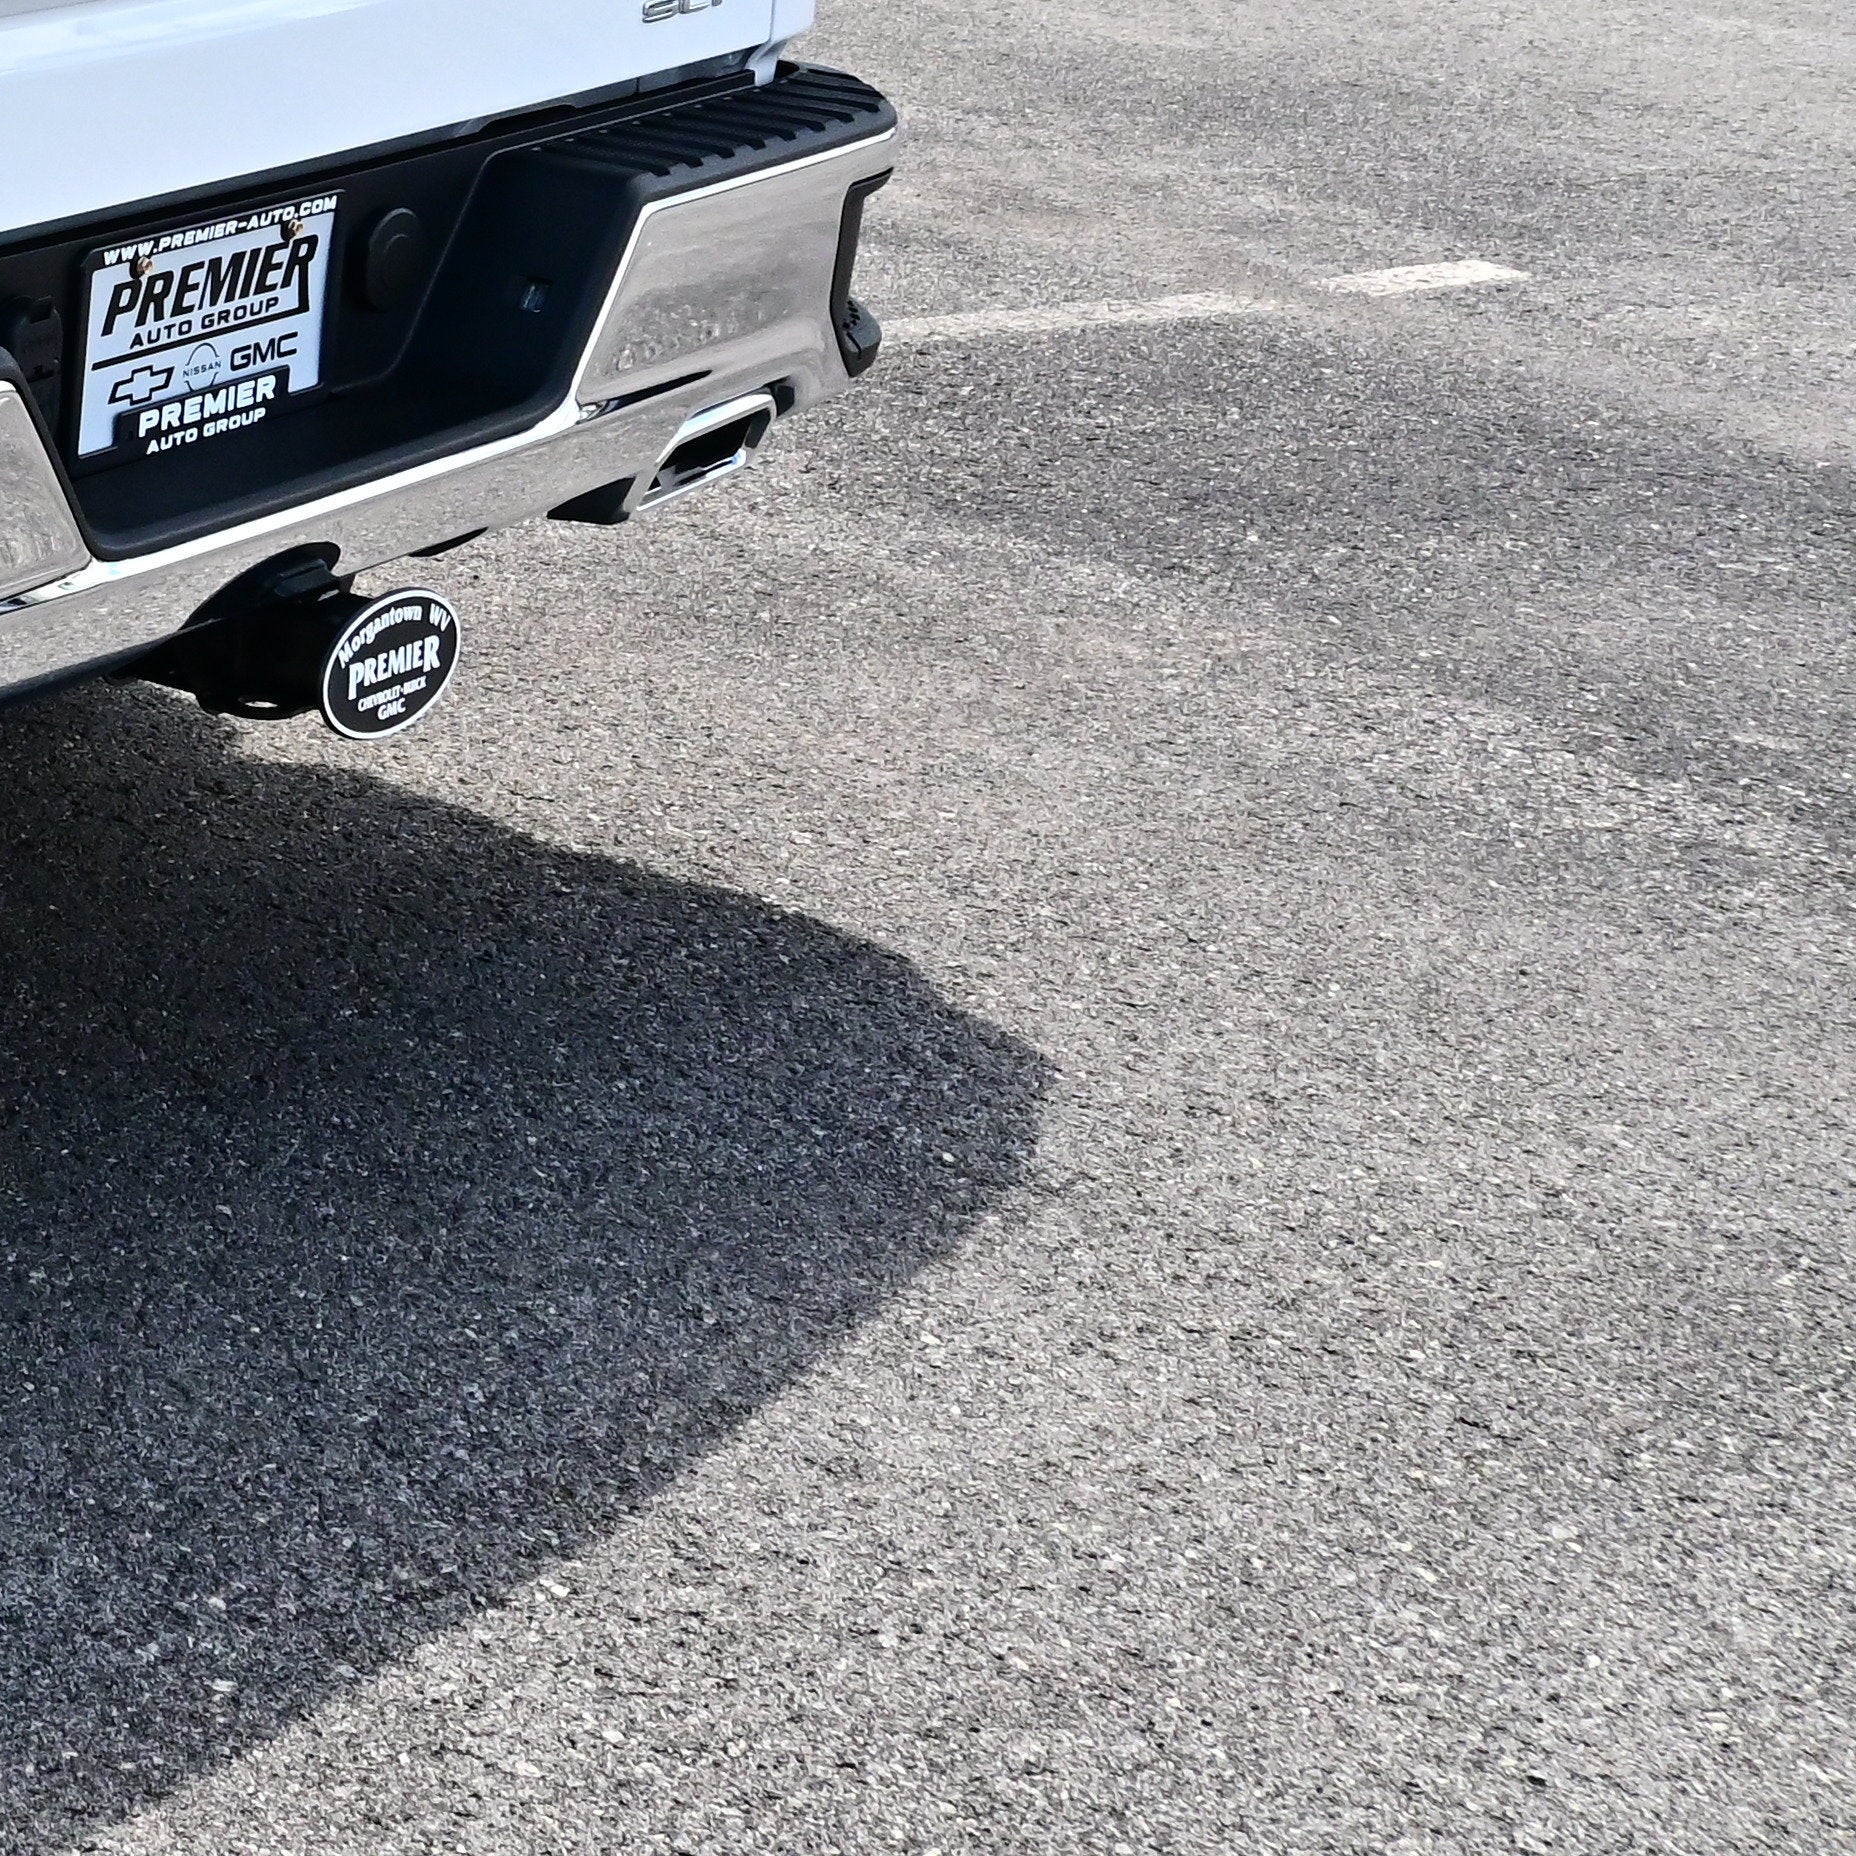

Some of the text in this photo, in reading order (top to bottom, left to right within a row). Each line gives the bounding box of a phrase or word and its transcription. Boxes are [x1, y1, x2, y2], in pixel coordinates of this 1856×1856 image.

[103, 195, 338, 266] WWW.PREMIER-AUTO.COM
[100, 233, 319, 337] PREMIER
[129, 296, 280, 350] AUTO GROUP
[229, 331, 299, 372] GMC
[182, 359, 222, 379] NISSAN
[137, 374, 277, 438] PREMIER
[146, 407, 267, 455] AUTO GROUP
[338, 602, 452, 669] Morgantown WV
[348, 634, 441, 701] PREMIER
[377, 697, 406, 721] GMC
